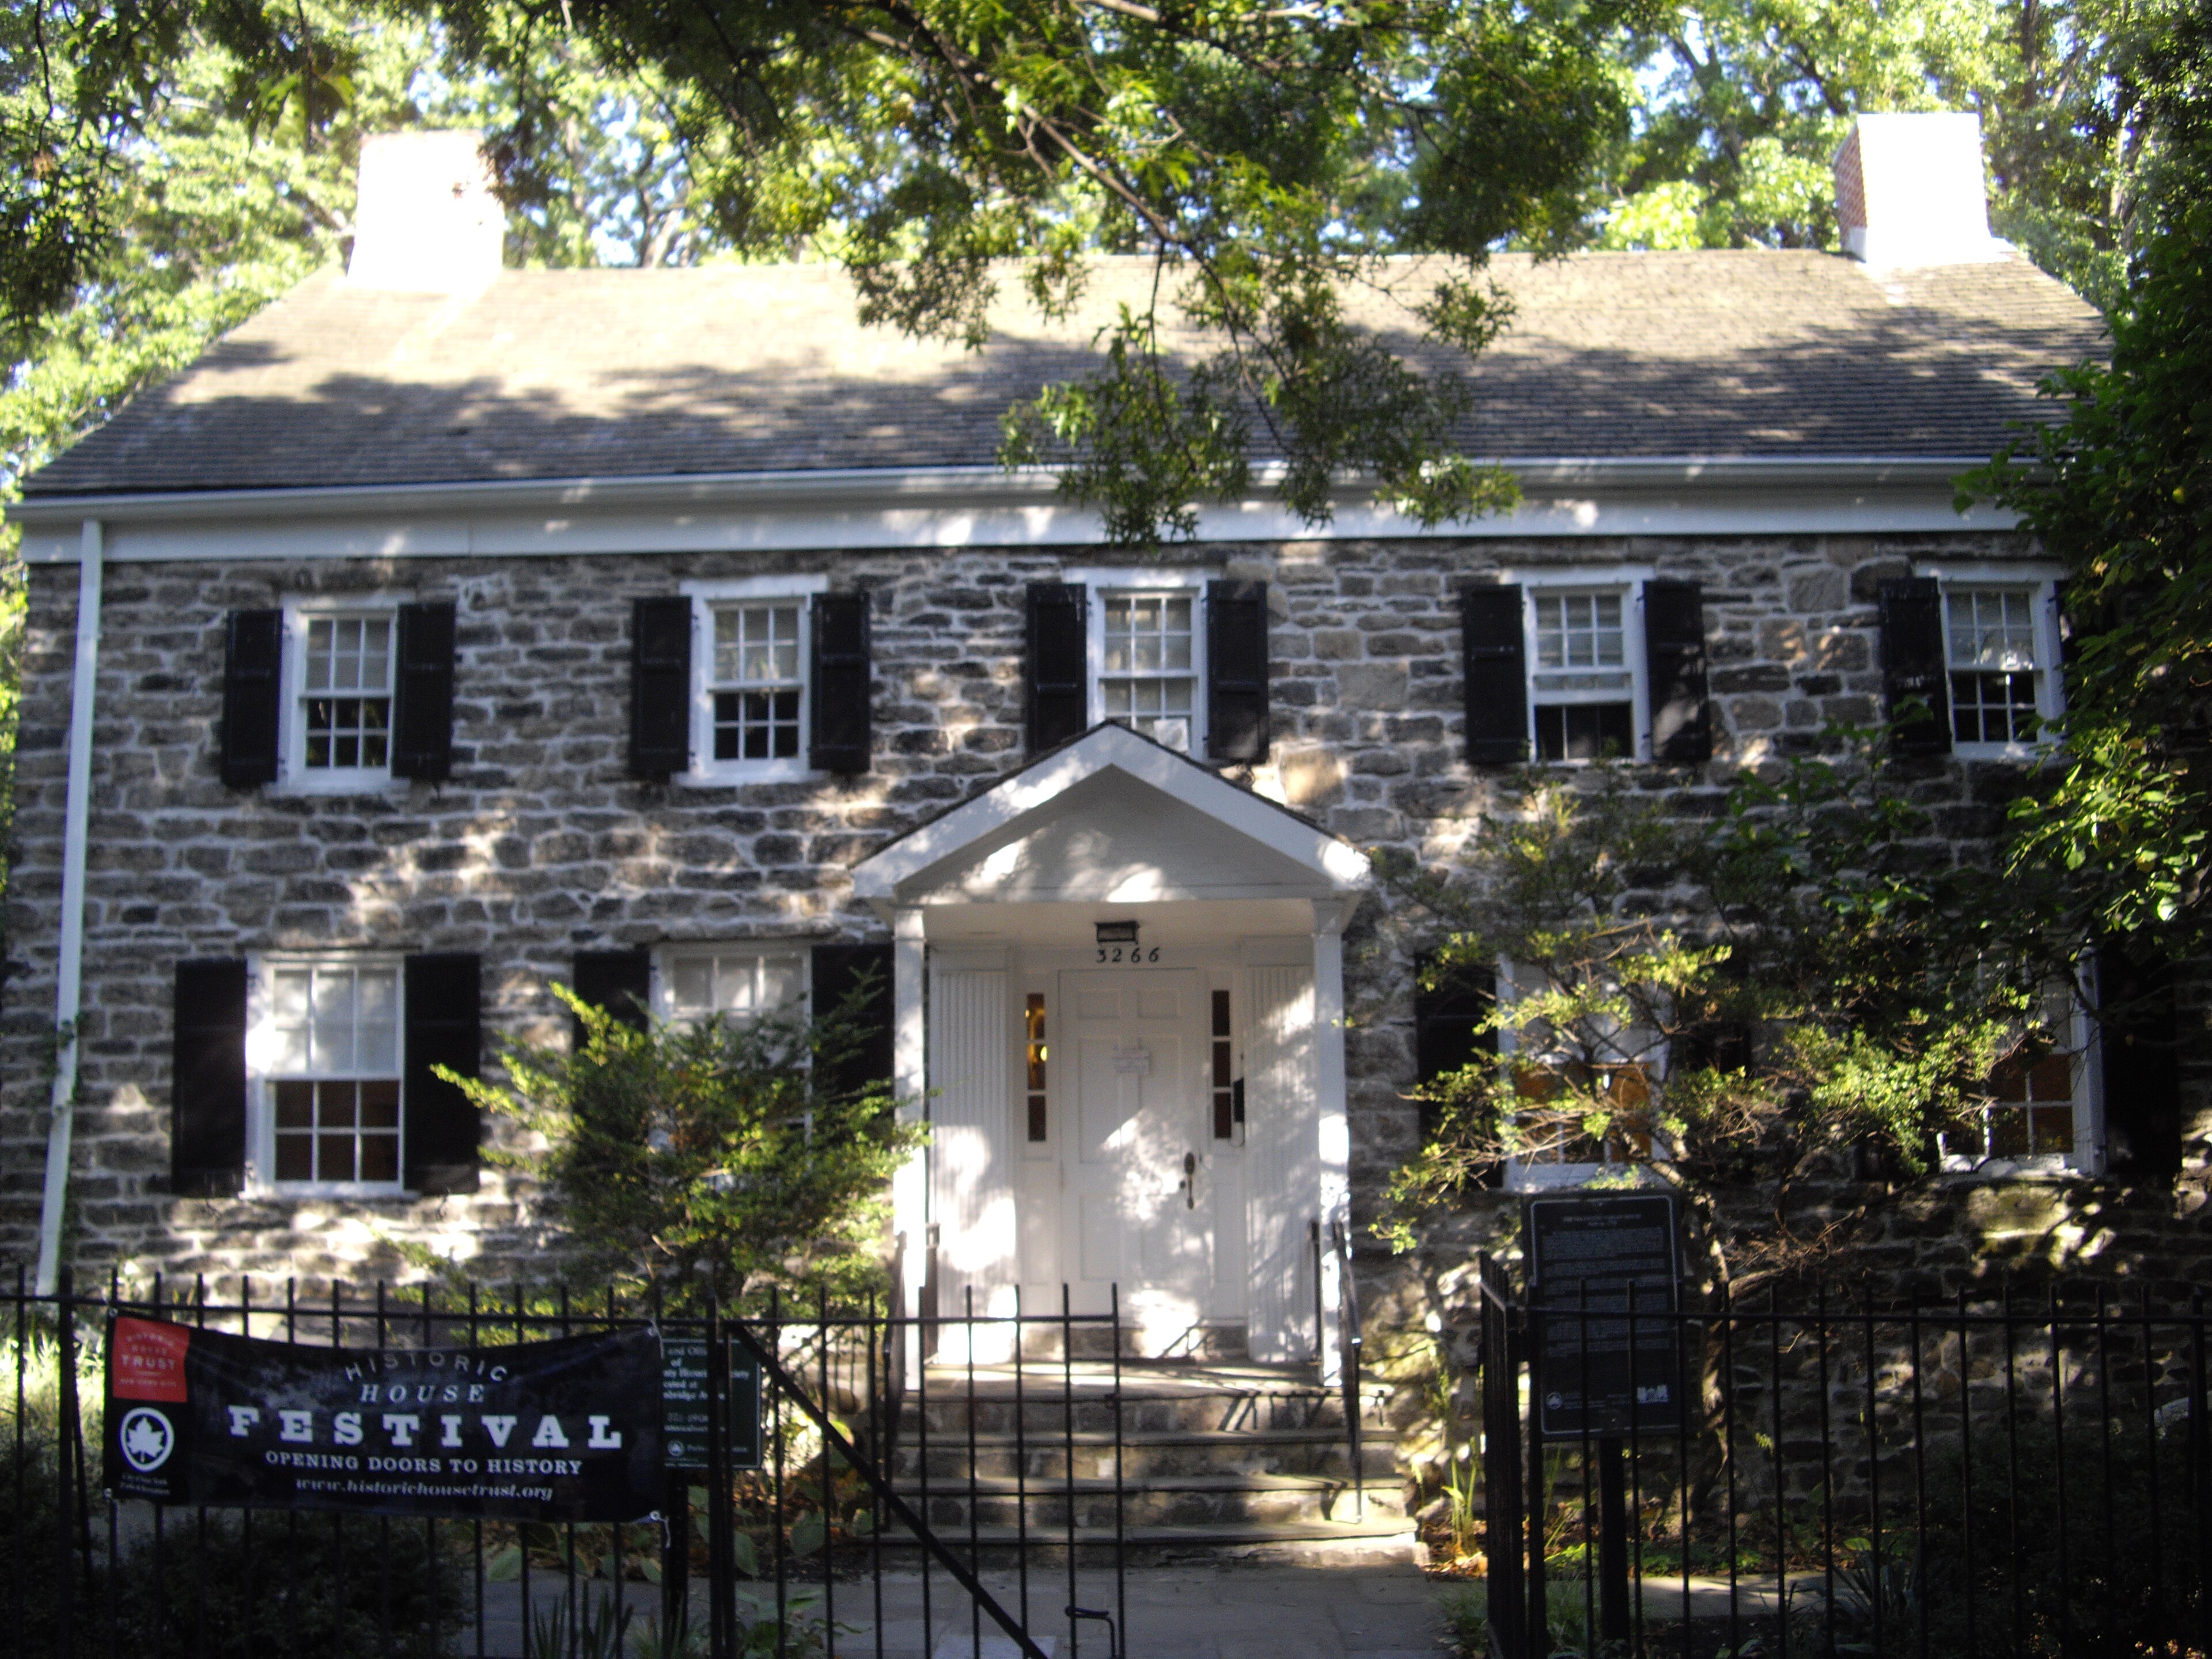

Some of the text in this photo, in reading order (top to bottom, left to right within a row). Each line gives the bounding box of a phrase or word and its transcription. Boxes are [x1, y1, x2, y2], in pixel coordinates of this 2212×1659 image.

[1096, 946, 1160, 964] 3266
[120, 1354, 176, 1371] TRUST
[345, 1352, 507, 1382] HISTORIC
[359, 1383, 486, 1403] HOUSE
[228, 1404, 623, 1449] FESTIVAL
[265, 1450, 584, 1475] OPENING DOORS TO HISTORY
[295, 1478, 553, 1500] www.historichousetrust.org
